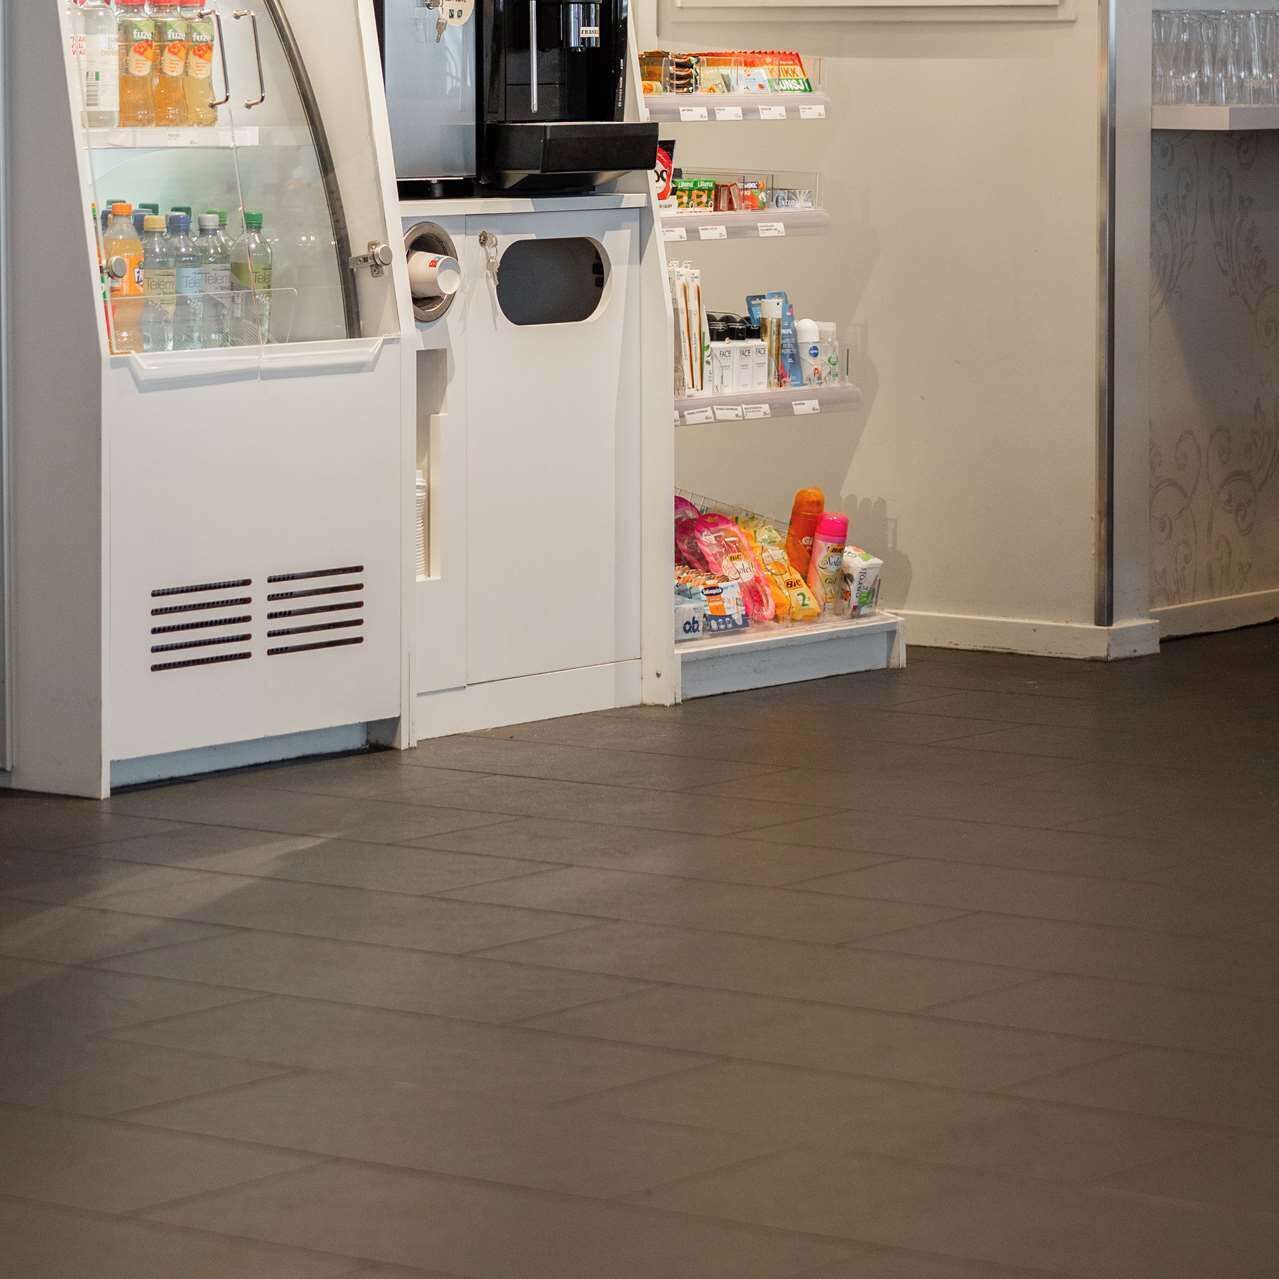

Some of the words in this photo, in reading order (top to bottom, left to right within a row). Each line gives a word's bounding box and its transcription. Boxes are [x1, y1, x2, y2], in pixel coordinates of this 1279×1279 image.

[719, 349, 732, 358] FACE
[785, 578, 803, 589] BIC
[796, 591, 810, 608] 2
